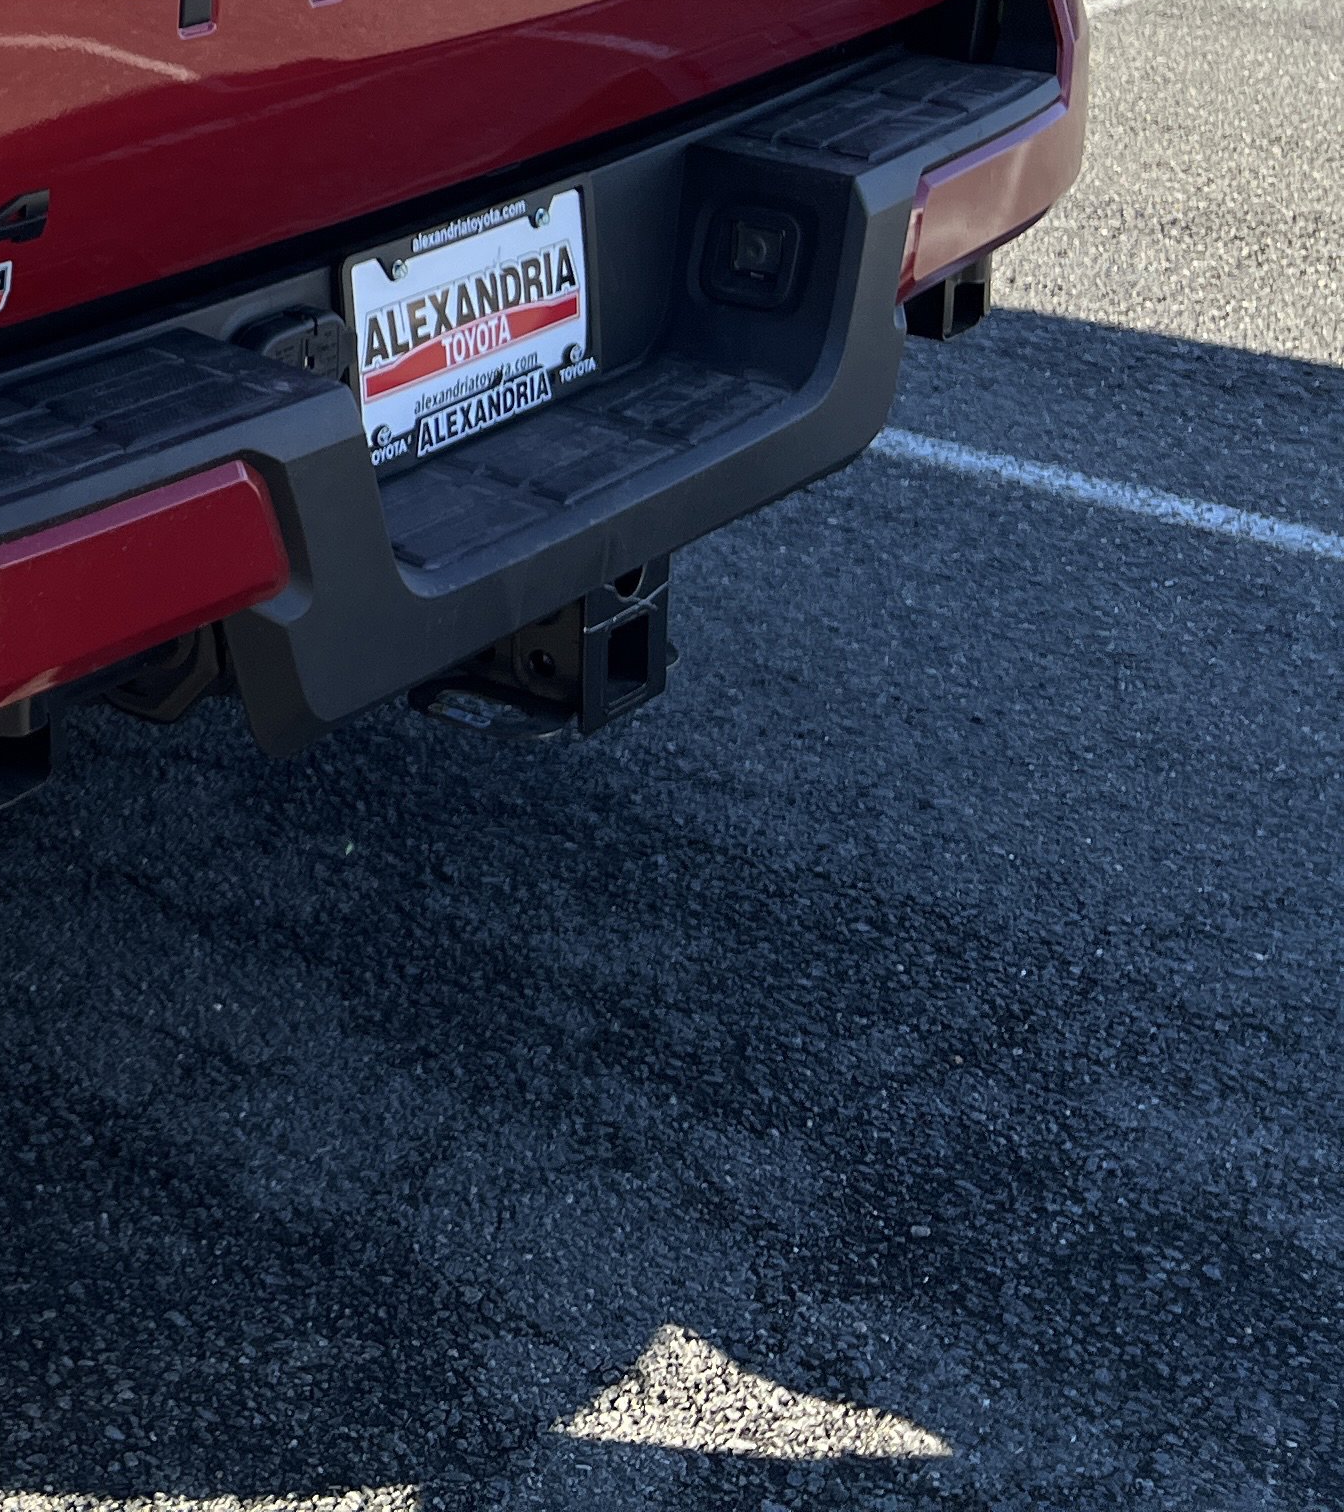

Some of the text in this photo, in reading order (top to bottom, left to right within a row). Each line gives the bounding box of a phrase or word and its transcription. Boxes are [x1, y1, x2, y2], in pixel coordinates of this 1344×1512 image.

[412, 199, 527, 253] alexandriatoyota.com
[363, 244, 578, 368] ALEXANDRIA
[441, 314, 512, 367] TOYOTA
[560, 356, 597, 384] TOYOTA
[418, 369, 551, 457] ALEXANDRIA
[369, 438, 408, 466] OYOTA
